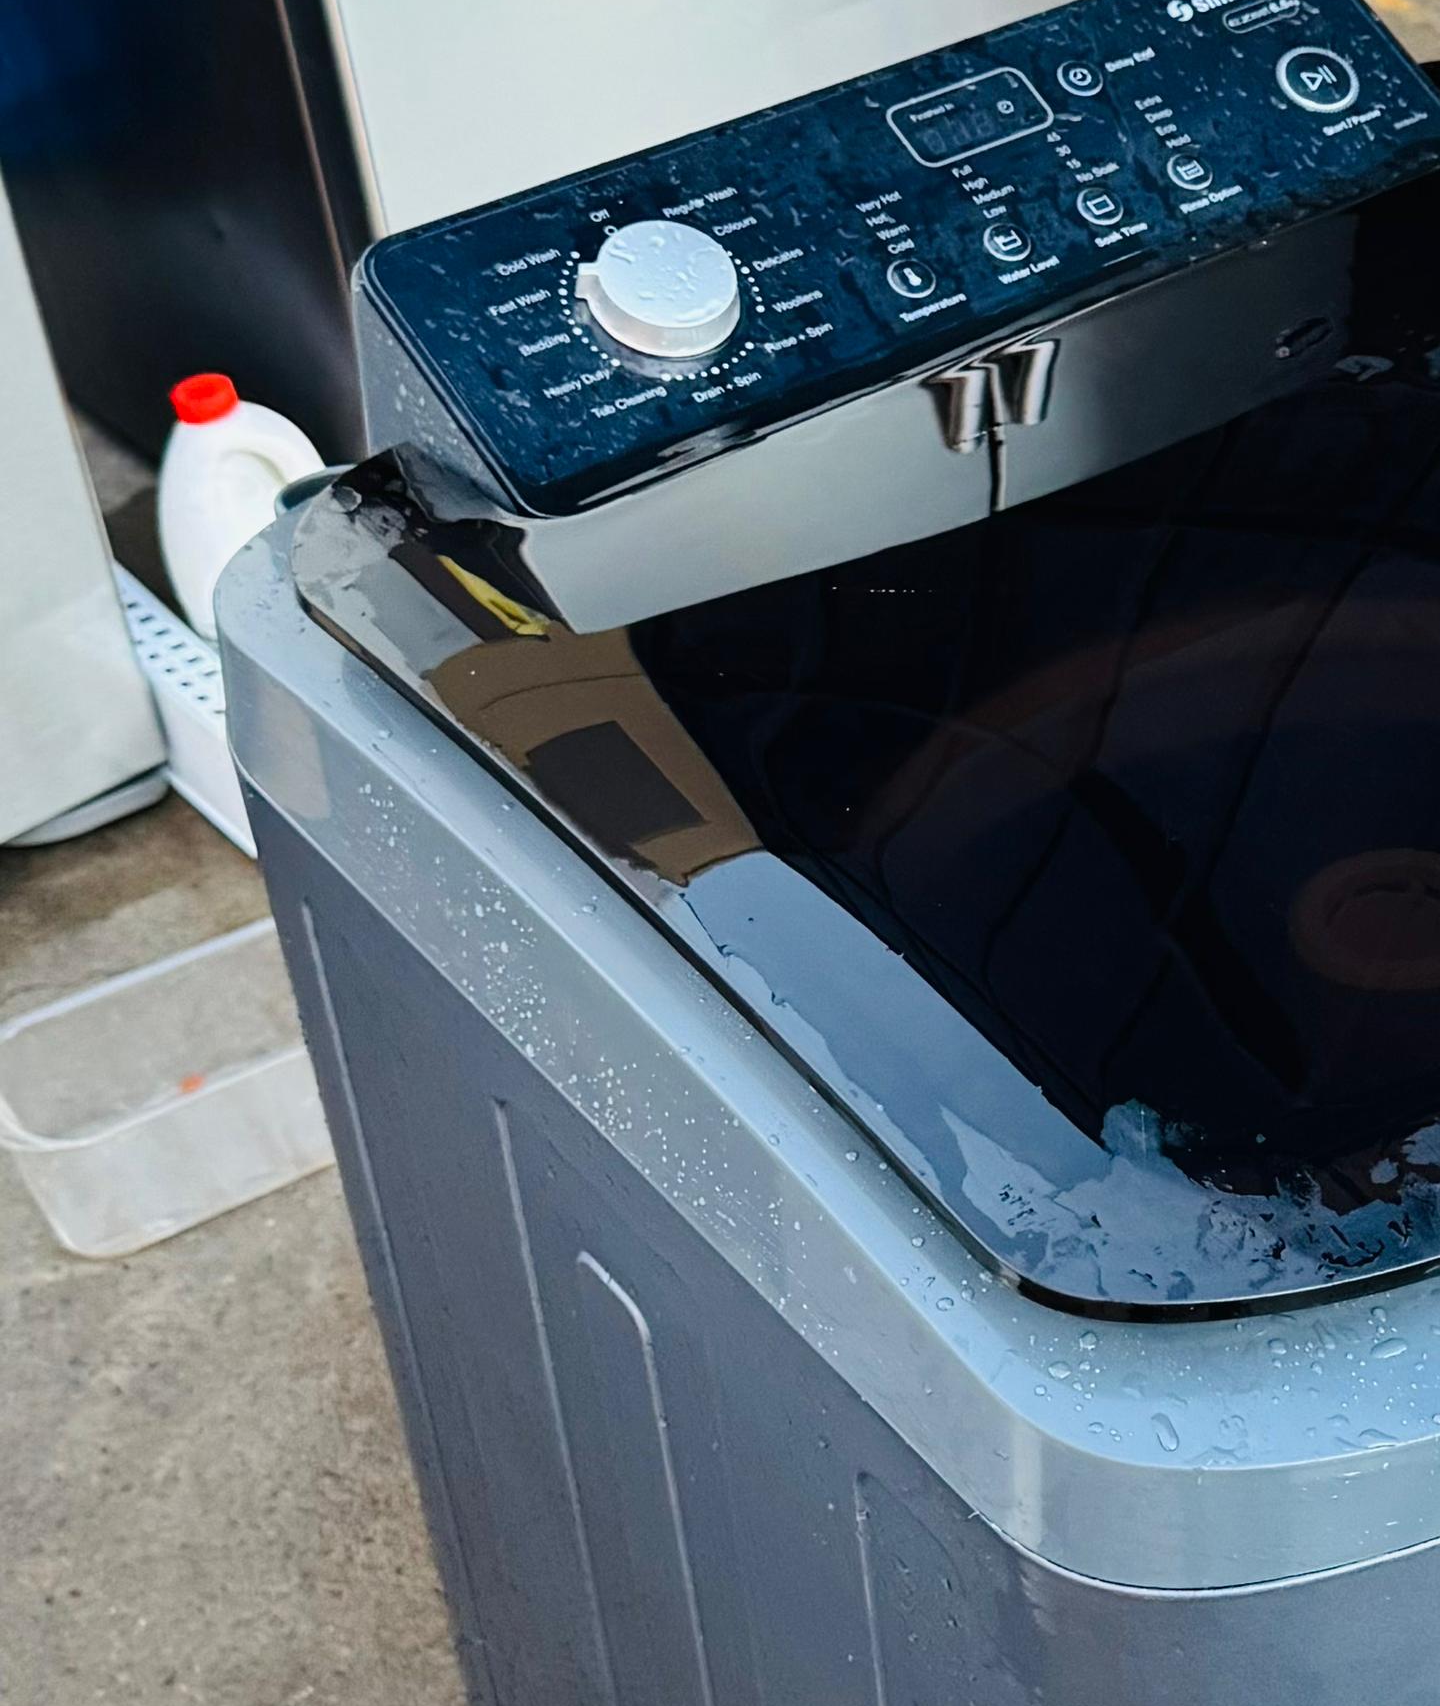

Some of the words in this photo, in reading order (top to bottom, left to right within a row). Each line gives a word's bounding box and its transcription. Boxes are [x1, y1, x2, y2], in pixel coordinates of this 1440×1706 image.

[1104, 57, 1138, 73] Delay
[1134, 95, 1163, 111] Extra
[1154, 123, 1178, 137] Eco
[1165, 133, 1192, 149] Hold
[951, 164, 973, 178] Full
[1075, 172, 1094, 183] No
[1091, 162, 1120, 178] Soak
[961, 177, 989, 192] High
[972, 184, 1015, 206] Medium
[662, 198, 706, 223] Regular
[700, 186, 738, 206] Wash
[855, 199, 883, 213] Very
[879, 190, 903, 205] Hot
[1179, 193, 1211, 214] Rinse
[1205, 185, 1243, 203] Option
[589, 208, 610, 223] Off
[865, 212, 891, 227] Hot
[982, 205, 1007, 219] Low
[712, 216, 758, 237] Colours
[875, 224, 911, 241] Warm
[1094, 229, 1123, 248] Soak
[1118, 222, 1148, 237] Time
[887, 238, 915, 255] Cold
[494, 256, 528, 276] Cold
[523, 248, 561, 266] Wash
[751, 248, 804, 272] Delicates
[998, 265, 1036, 285] Water
[1026, 255, 1060, 273] Level
[487, 297, 522, 317] Fast
[514, 289, 552, 307] Wash
[771, 290, 824, 313] Woollens
[899, 293, 967, 323] Temperature
[519, 332, 571, 357] Bedding
[762, 336, 798, 356] Rinse
[805, 322, 834, 338] Spin
[542, 375, 587, 399] Heavy
[579, 364, 613, 385] Duty
[691, 386, 726, 403] Drain
[733, 372, 762, 388] Spin
[590, 401, 620, 419] Tub
[611, 385, 668, 411] Cleaning
